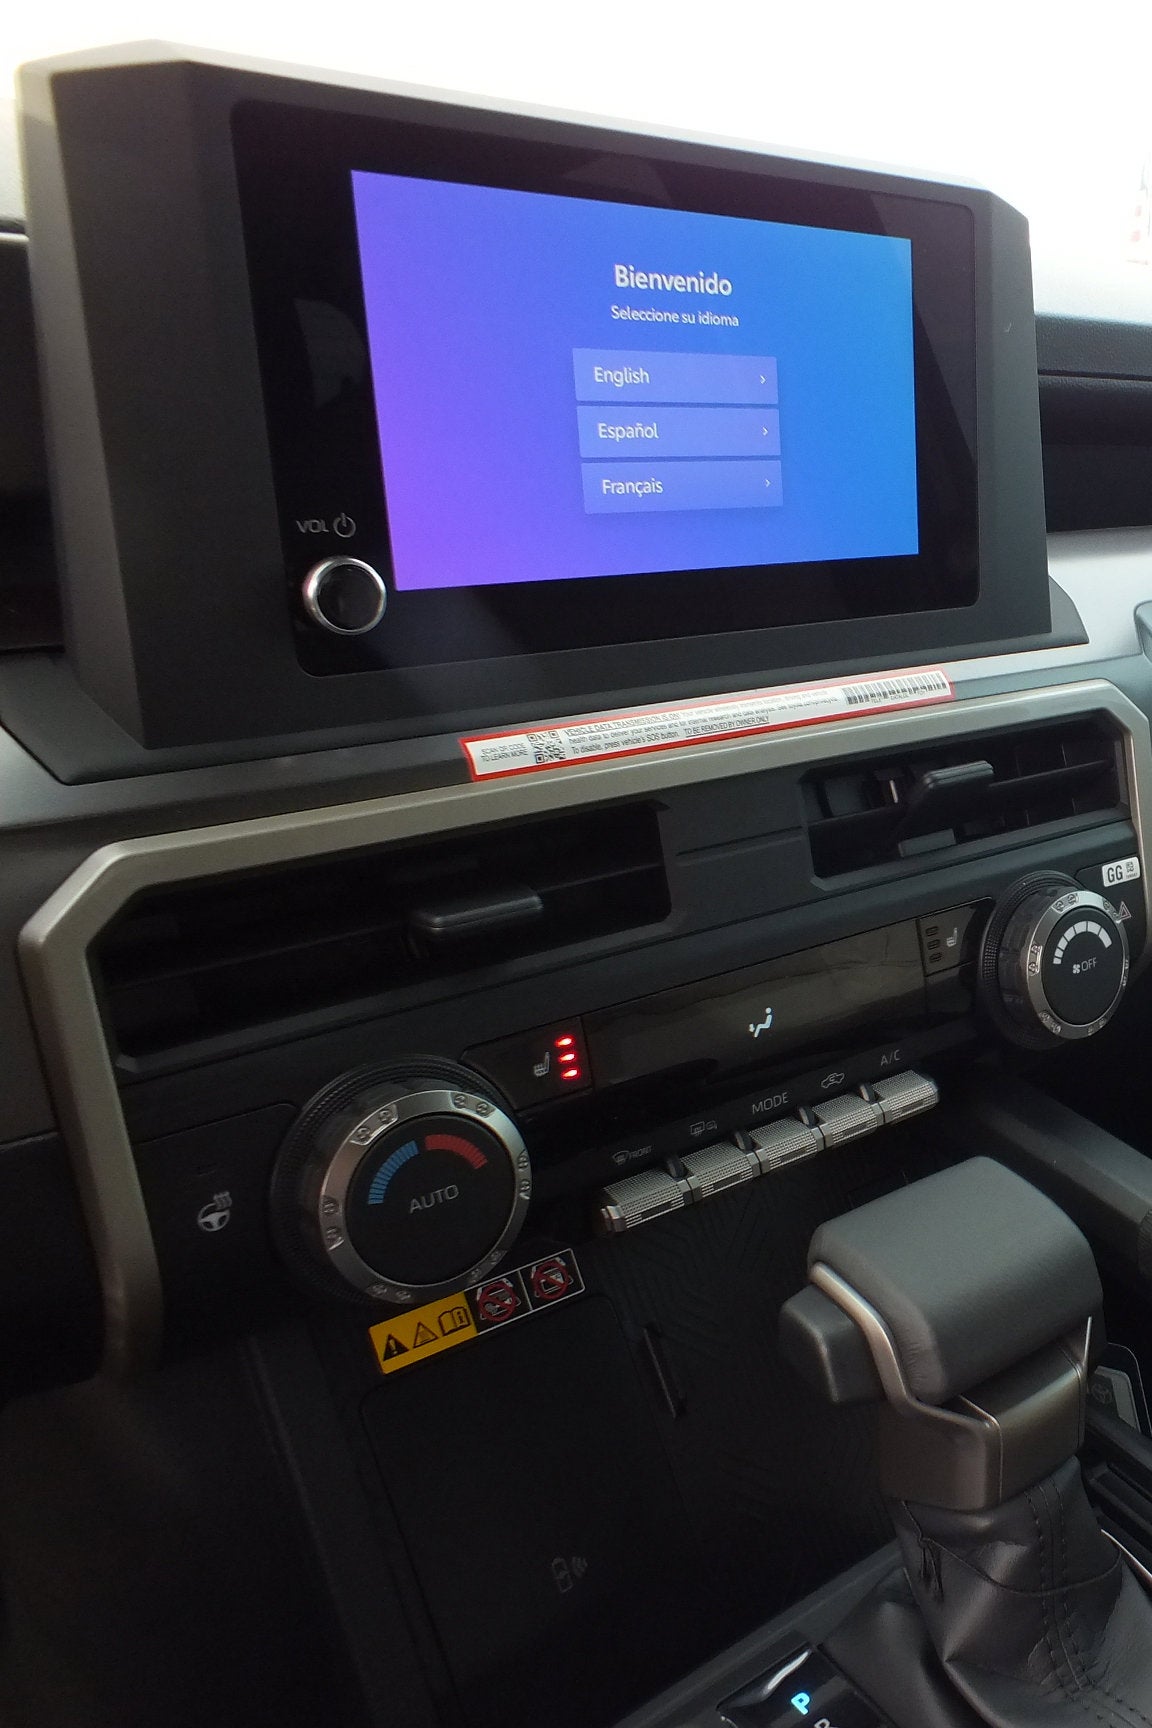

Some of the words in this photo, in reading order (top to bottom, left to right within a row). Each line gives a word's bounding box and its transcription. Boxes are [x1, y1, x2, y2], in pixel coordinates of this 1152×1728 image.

[614, 264, 733, 296] Bienvenido
[611, 305, 679, 323] Seleccione
[682, 313, 696, 324] su
[698, 310, 739, 327] idioma
[594, 366, 650, 387] English
[598, 422, 659, 442] Español
[602, 477, 663, 497] Français
[295, 519, 329, 533] VOL
[564, 727, 595, 737] VEHICLE
[595, 723, 612, 732] DATA
[613, 716, 660, 729] TRANSMISSION
[572, 746, 580, 755] To
[604, 741, 621, 751] press
[647, 733, 660, 743] SOS
[684, 727, 693, 735] TO
[701, 722, 727, 733] REMOVED
[736, 717, 755, 728] OWNER
[756, 714, 769, 725] ONLY
[1107, 864, 1123, 883] GG
[1081, 957, 1097, 972] OFF
[881, 1049, 900, 1067] A/C
[751, 1092, 788, 1115] MODE
[409, 1184, 459, 1214] AUTO
[790, 1692, 810, 1715] P
